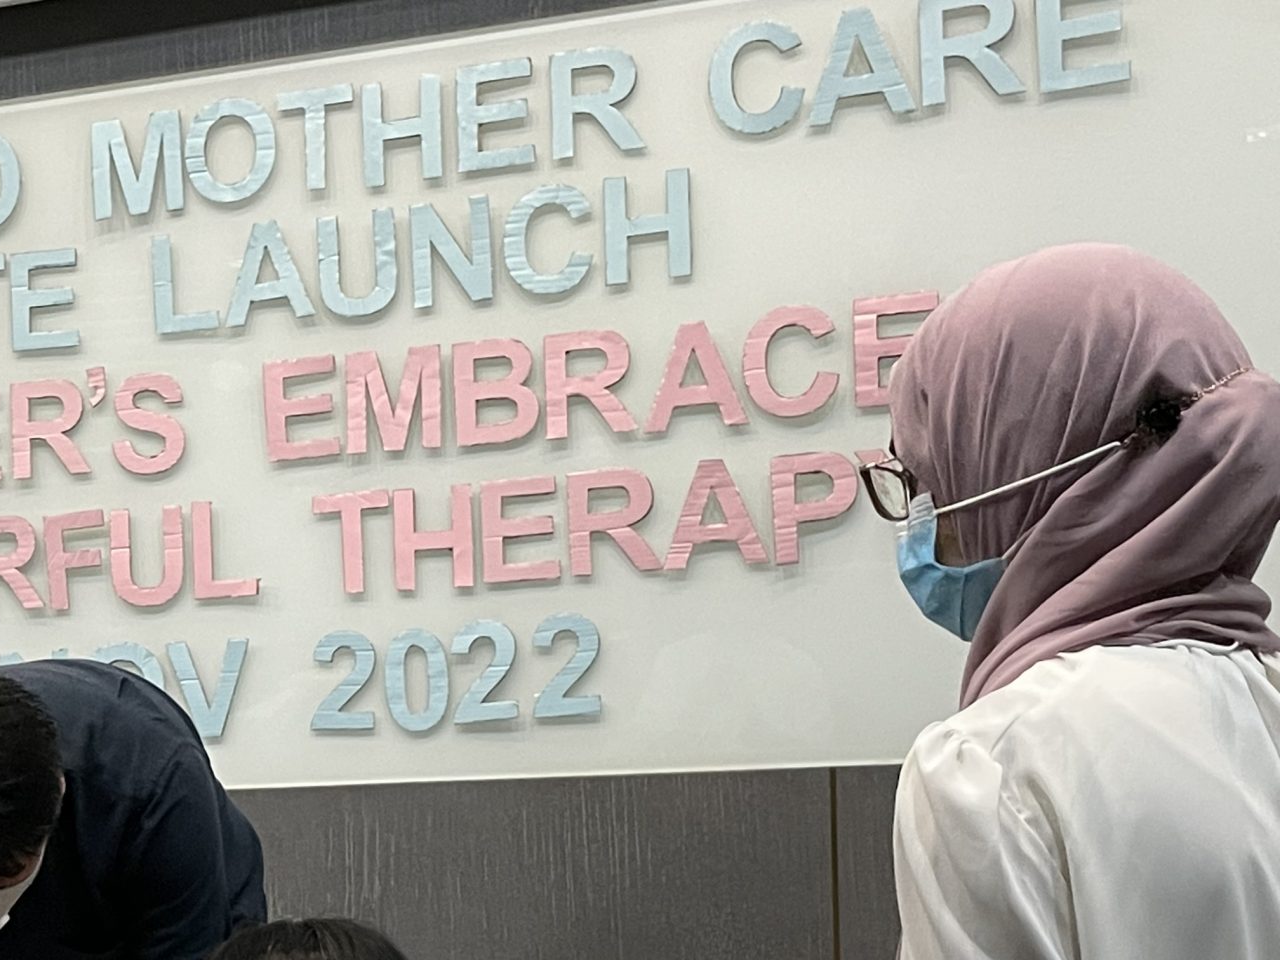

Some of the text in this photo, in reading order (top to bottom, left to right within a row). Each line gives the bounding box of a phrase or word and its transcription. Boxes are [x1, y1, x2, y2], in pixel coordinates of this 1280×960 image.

[91, 48, 645, 220] MOTHER
[709, 0, 1131, 136] CARE
[151, 168, 692, 335] LAUNCH
[263, 290, 939, 462] EMBRACE
[312, 449, 904, 594] THERAP
[310, 612, 602, 732] 2022
